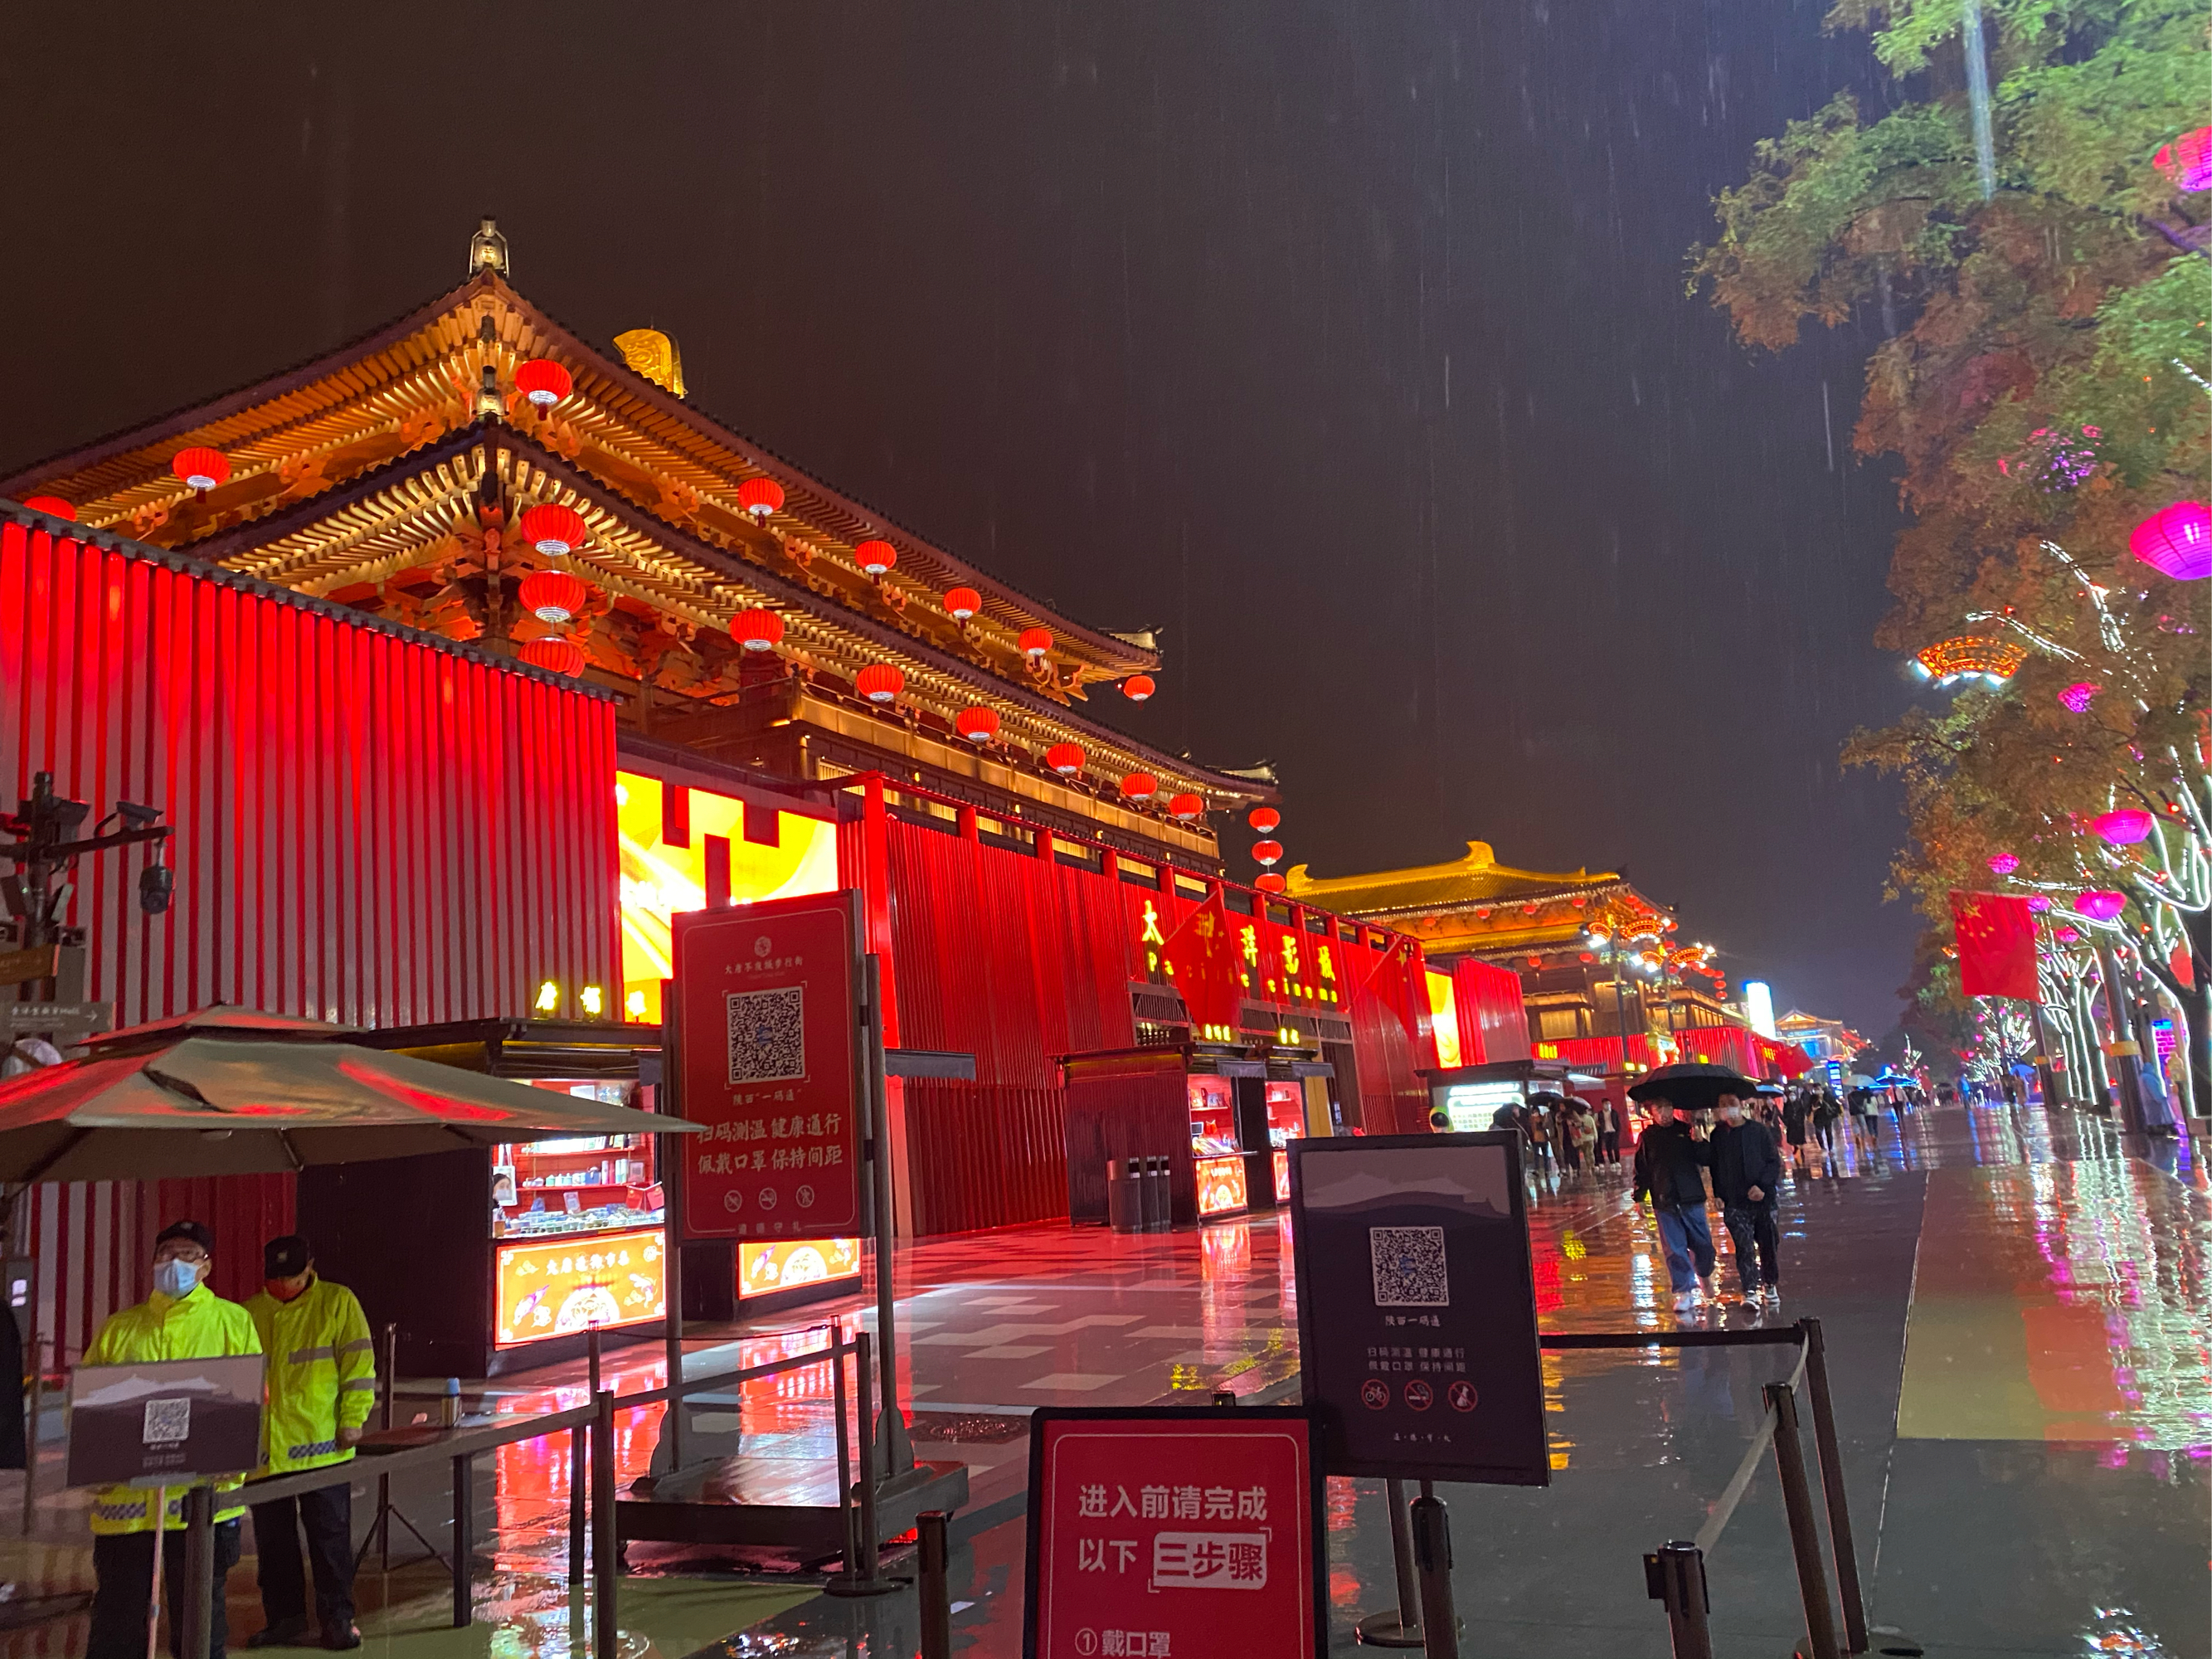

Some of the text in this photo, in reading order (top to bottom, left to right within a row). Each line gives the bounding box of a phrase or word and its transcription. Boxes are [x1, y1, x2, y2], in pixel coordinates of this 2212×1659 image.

[696, 1112, 842, 1144] 扫码测温 健康通行
[698, 1144, 843, 1175] 佩戴口罩 保持间距
[1384, 1314, 1441, 1327] 陕西一码通
[1419, 1361, 1466, 1373] 保持间距
[1078, 1484, 1268, 1521] 进入前请完成
[1078, 1537, 1264, 1582] 以下 三步骤
